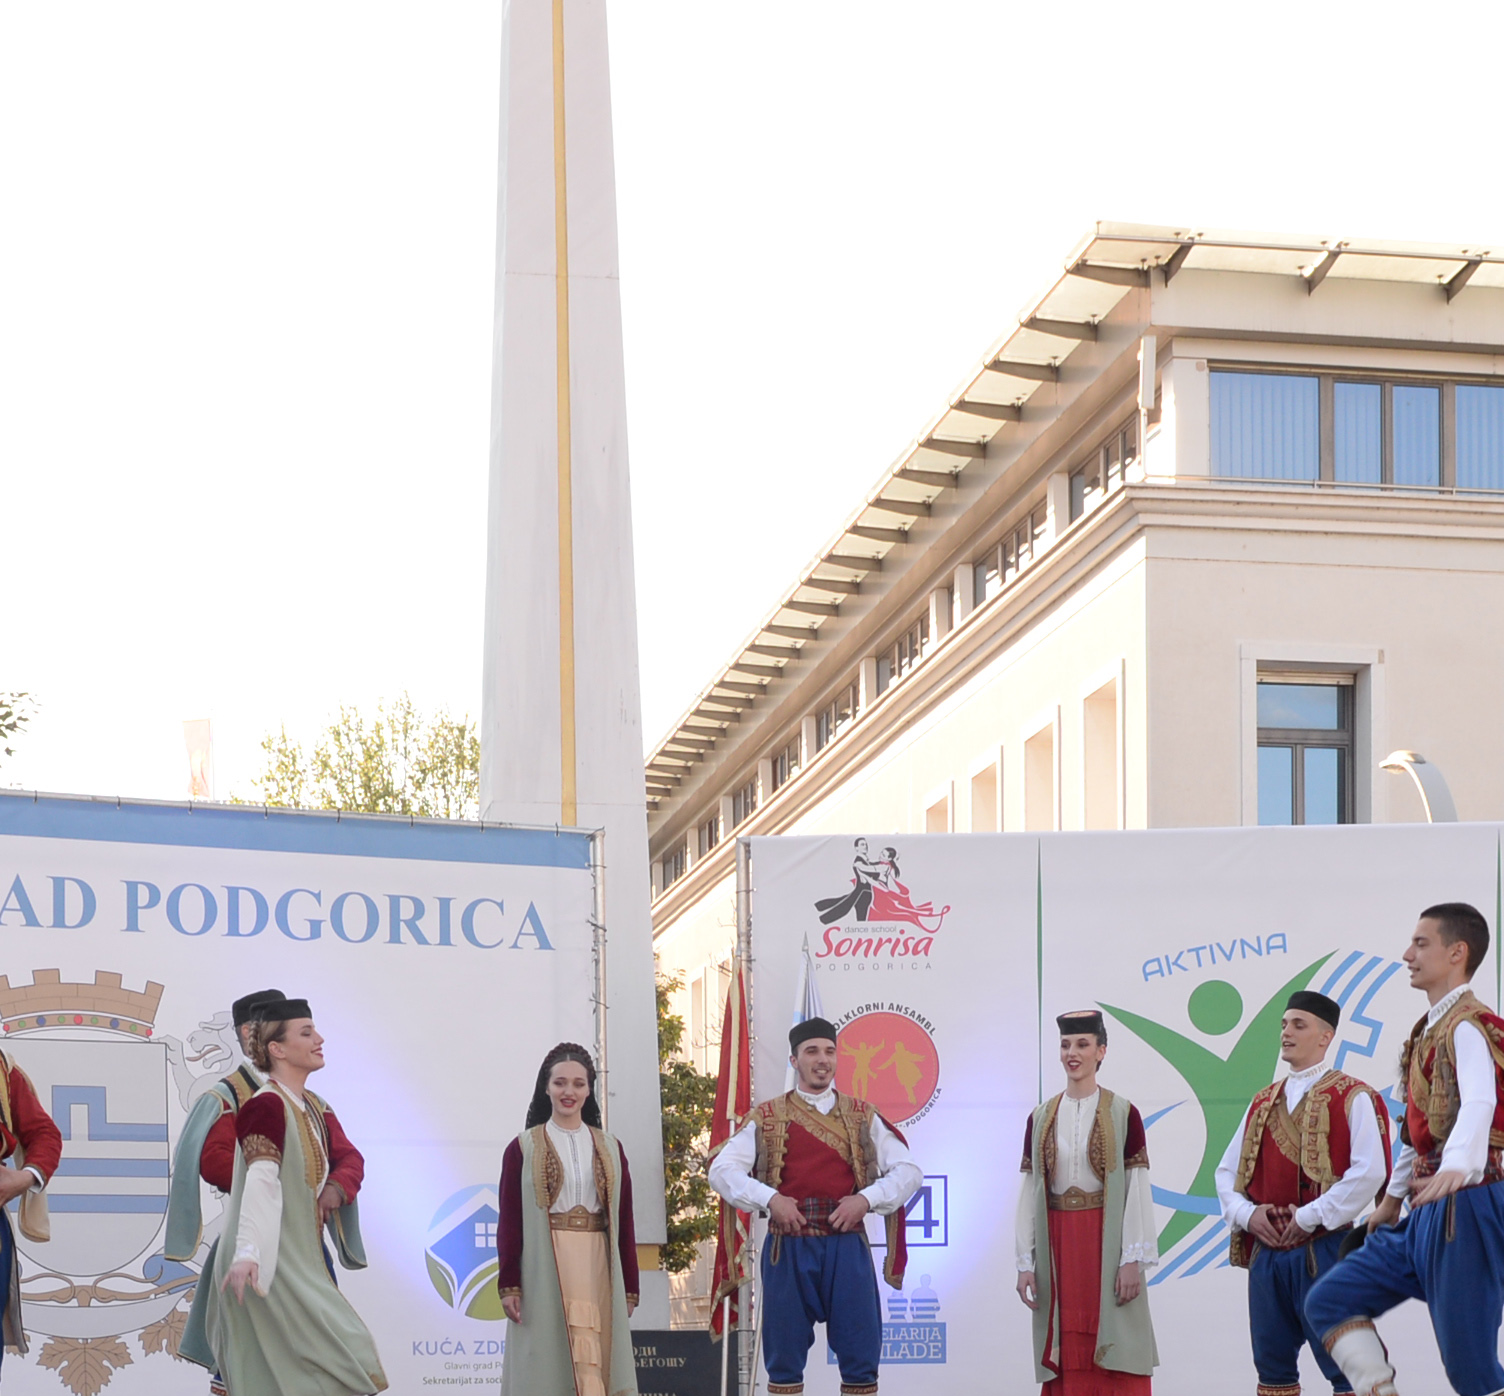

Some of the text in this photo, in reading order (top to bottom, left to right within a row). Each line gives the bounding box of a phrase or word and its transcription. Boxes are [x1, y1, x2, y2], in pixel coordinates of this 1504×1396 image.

[119, 879, 556, 951] PODGORICA
[844, 925, 896, 933] dance school
[815, 926, 934, 958] Sonrisa
[1142, 933, 1288, 982] AKTIVNA
[815, 962, 932, 971] PODGORICA
[834, 1001, 937, 1036] OLKLORNI ANSAMBL
[882, 1327, 942, 1343] ELARIJA
[412, 1337, 466, 1356] KUĆA
[444, 1361, 471, 1370] Glavni
[473, 1361, 493, 1372] grad
[422, 1376, 472, 1386] Sekretarijat
